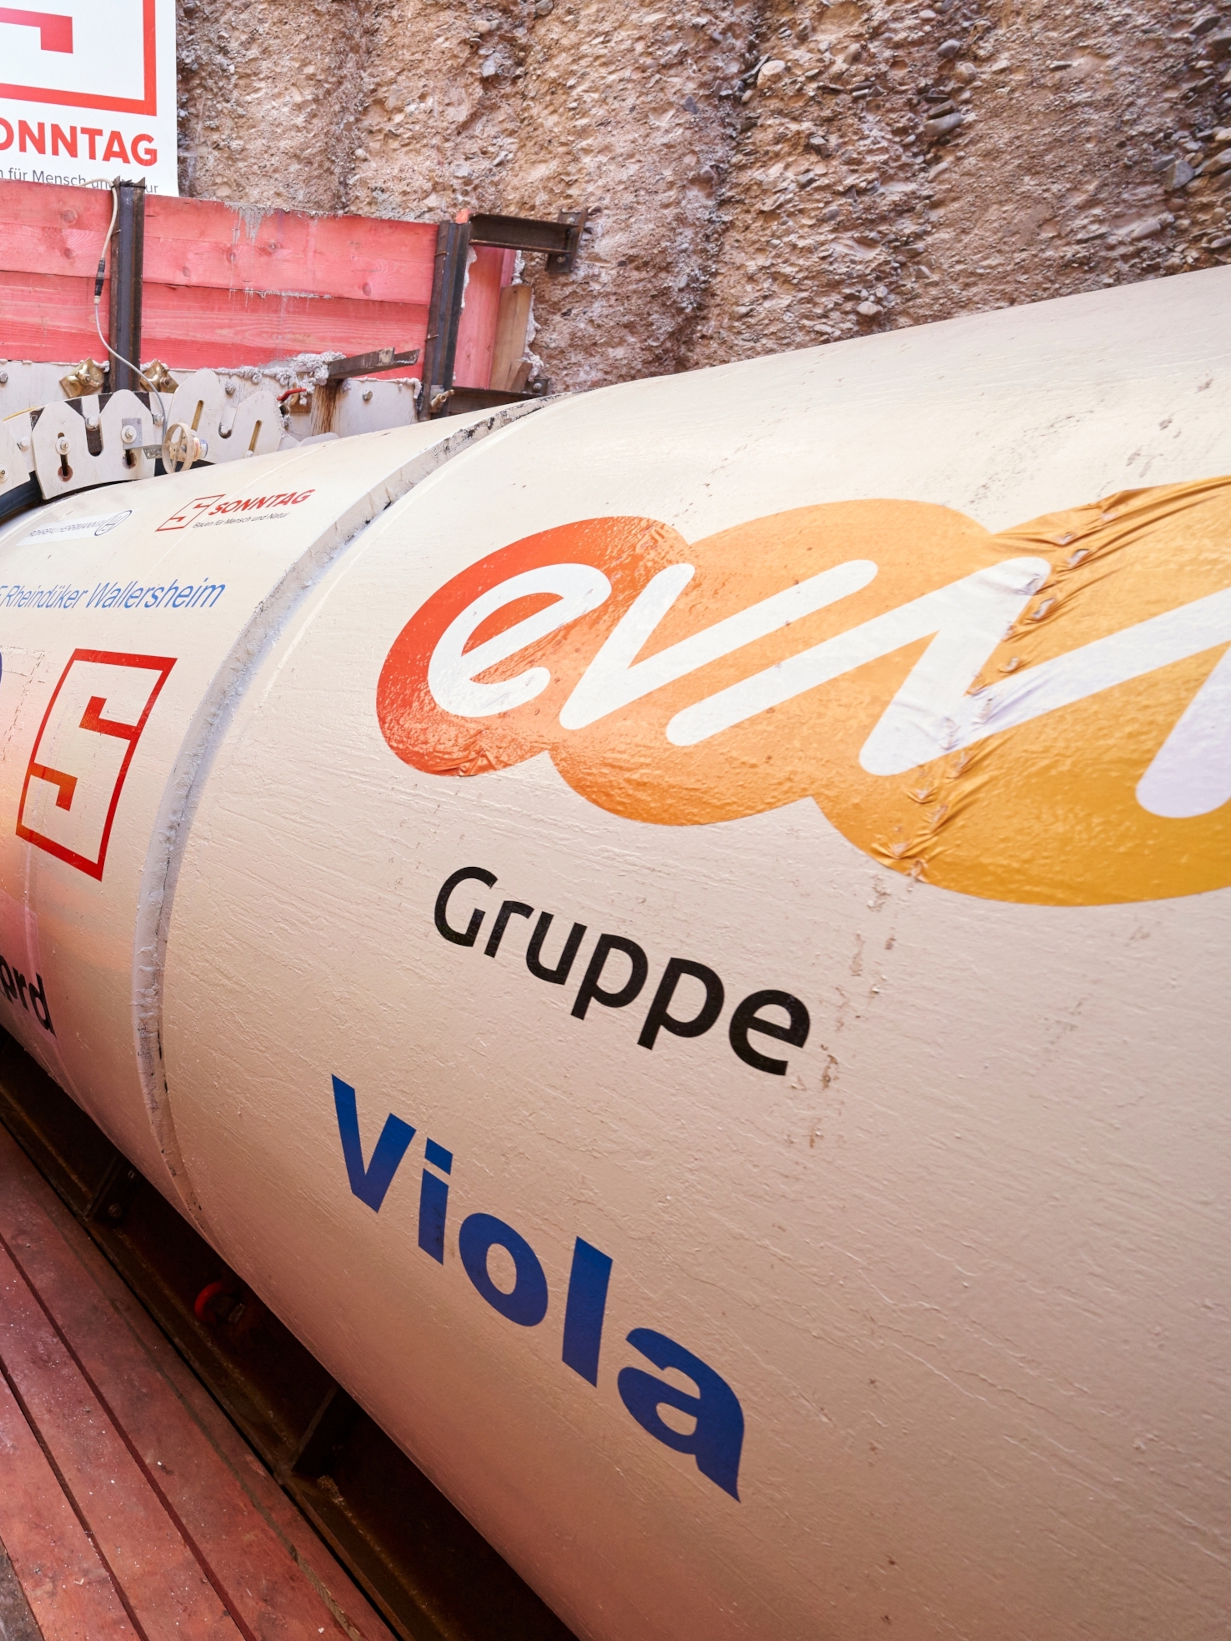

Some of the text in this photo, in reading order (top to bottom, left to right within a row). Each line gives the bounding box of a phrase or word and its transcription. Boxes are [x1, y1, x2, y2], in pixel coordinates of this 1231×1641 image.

[8, 166, 28, 181] für
[208, 488, 316, 516] SONNTAG
[224, 516, 252, 526] Mensch
[251, 514, 269, 522] und
[268, 512, 291, 521] Natur
[1, 584, 88, 608] Rheindüker
[85, 577, 226, 608] Wallersheim
[434, 865, 811, 1076] Gruppe
[331, 1074, 745, 1503] Viola
